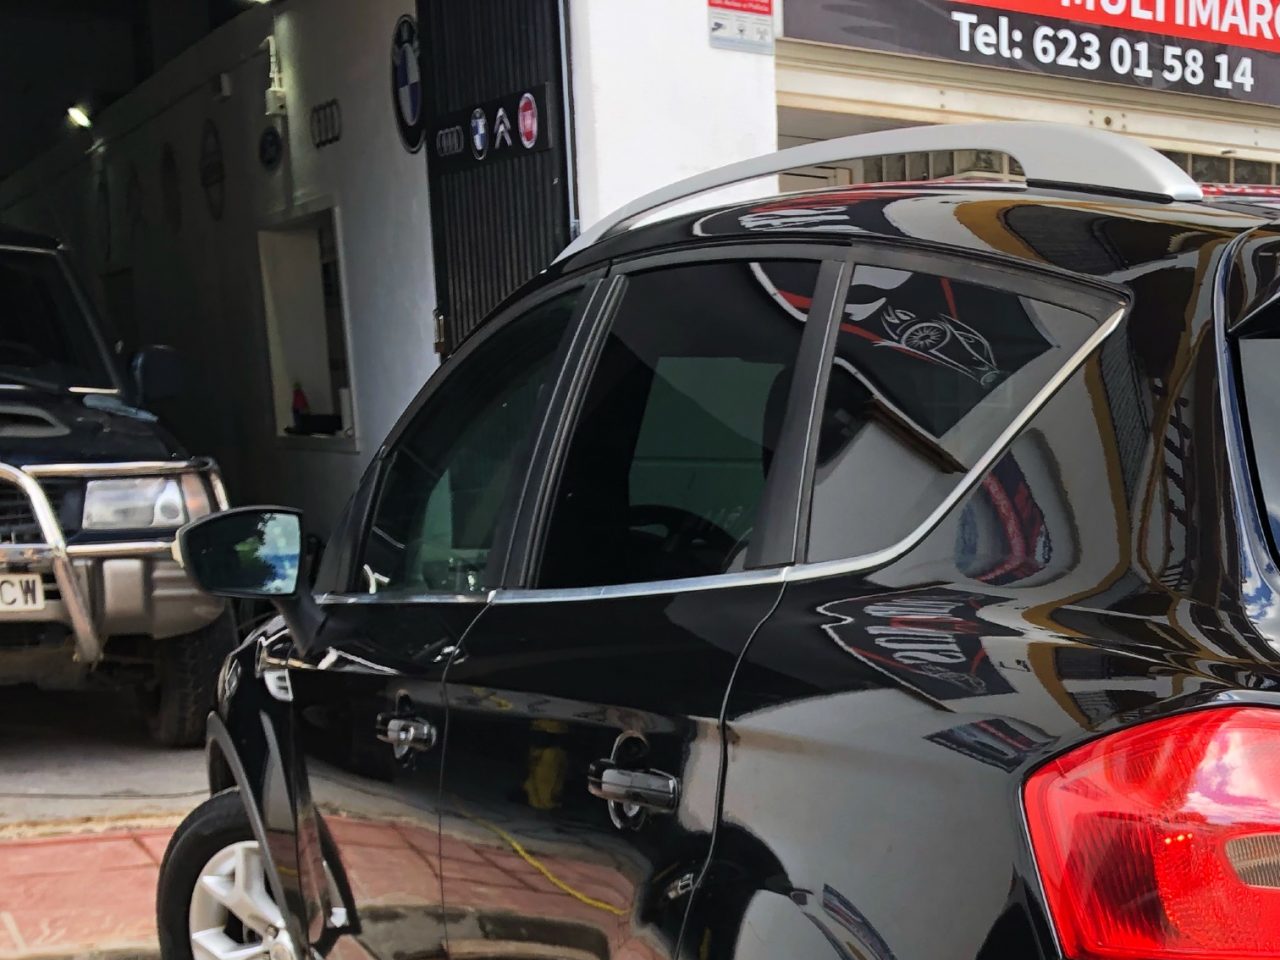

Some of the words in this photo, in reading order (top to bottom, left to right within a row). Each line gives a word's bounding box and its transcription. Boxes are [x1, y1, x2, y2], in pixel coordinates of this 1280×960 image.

[951, 11, 1022, 59] Tel:
[1032, 25, 1101, 70] 623
[1109, 36, 1153, 78] 01
[1162, 44, 1203, 85] 58
[1214, 53, 1254, 92] 14
[0, 579, 37, 605] CW
